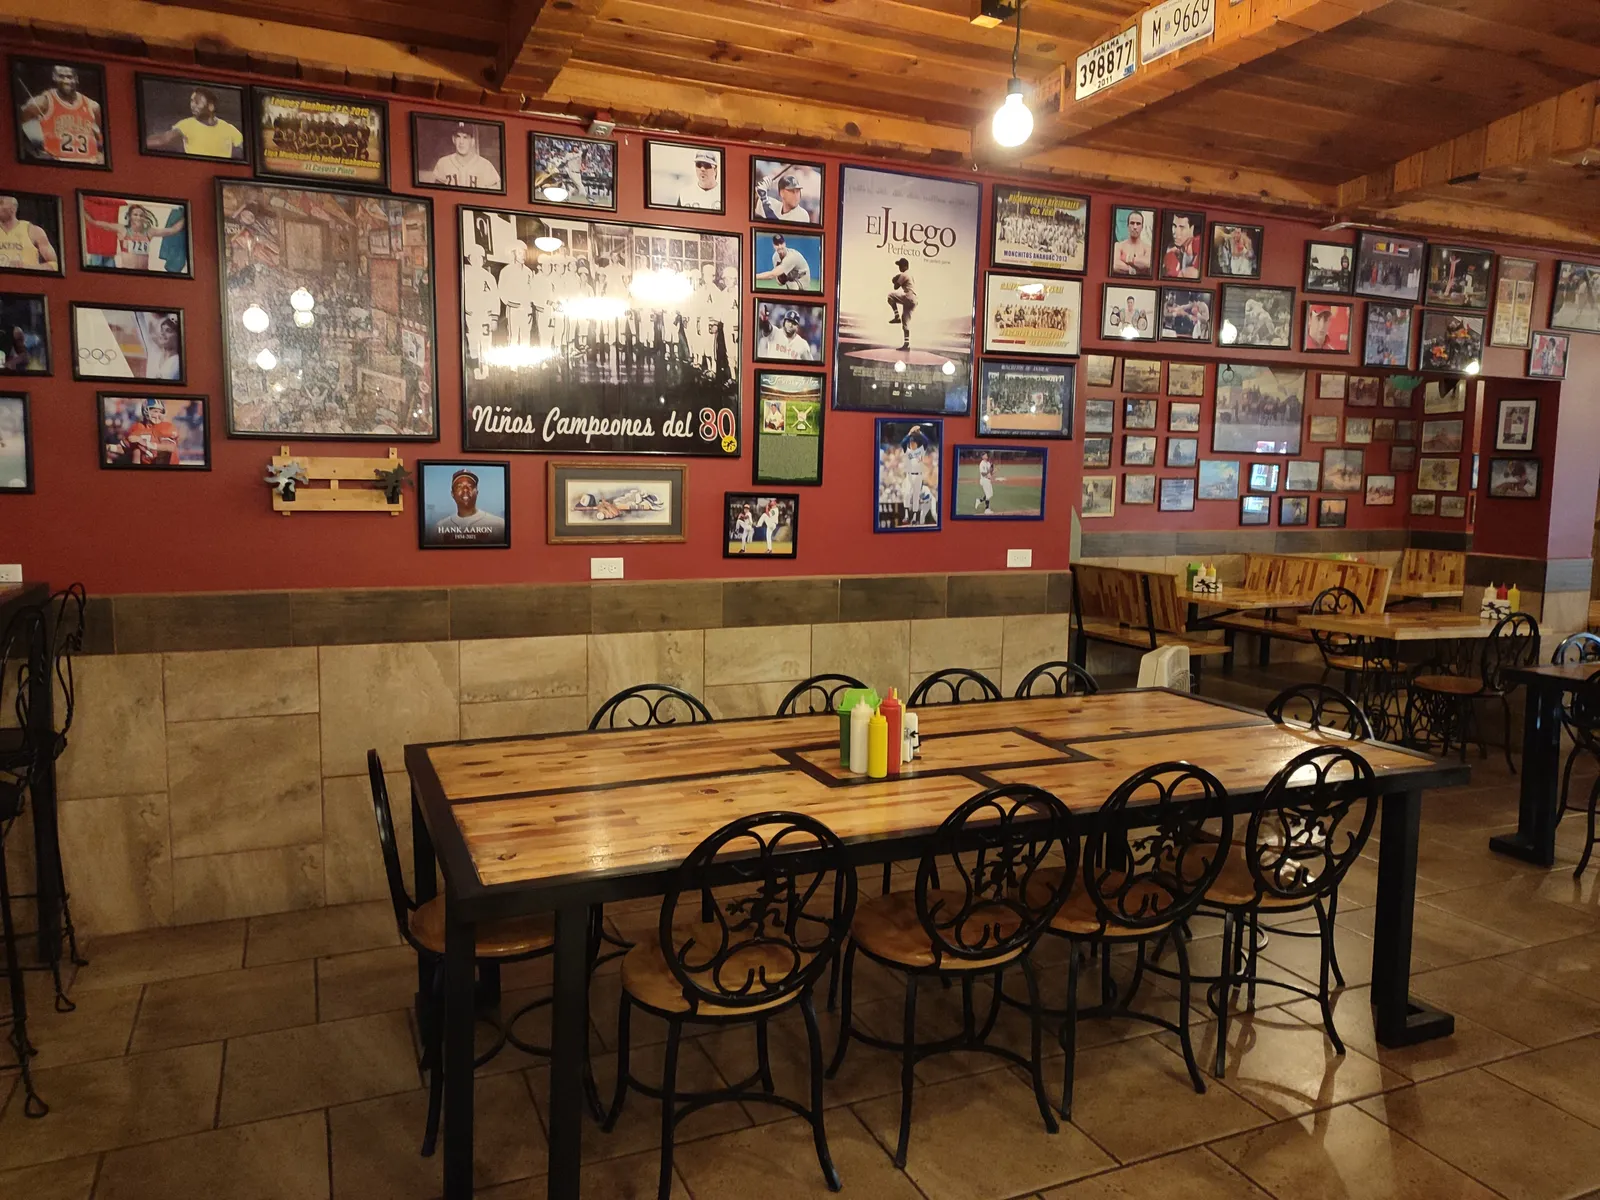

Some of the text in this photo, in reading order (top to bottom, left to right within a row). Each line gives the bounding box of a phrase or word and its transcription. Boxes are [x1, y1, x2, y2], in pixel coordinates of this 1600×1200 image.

[1152, 16, 1162, 47] M
[1173, 0, 1210, 38] 9669
[1094, 39, 1120, 55] PANAMA
[1080, 39, 1133, 88] 398877
[1097, 75, 1113, 89] 2011
[61, 133, 87, 153] 23
[865, 206, 957, 258] El Juego
[887, 243, 921, 257] Perfecto
[472, 405, 736, 443] Niños Campeones del 80
